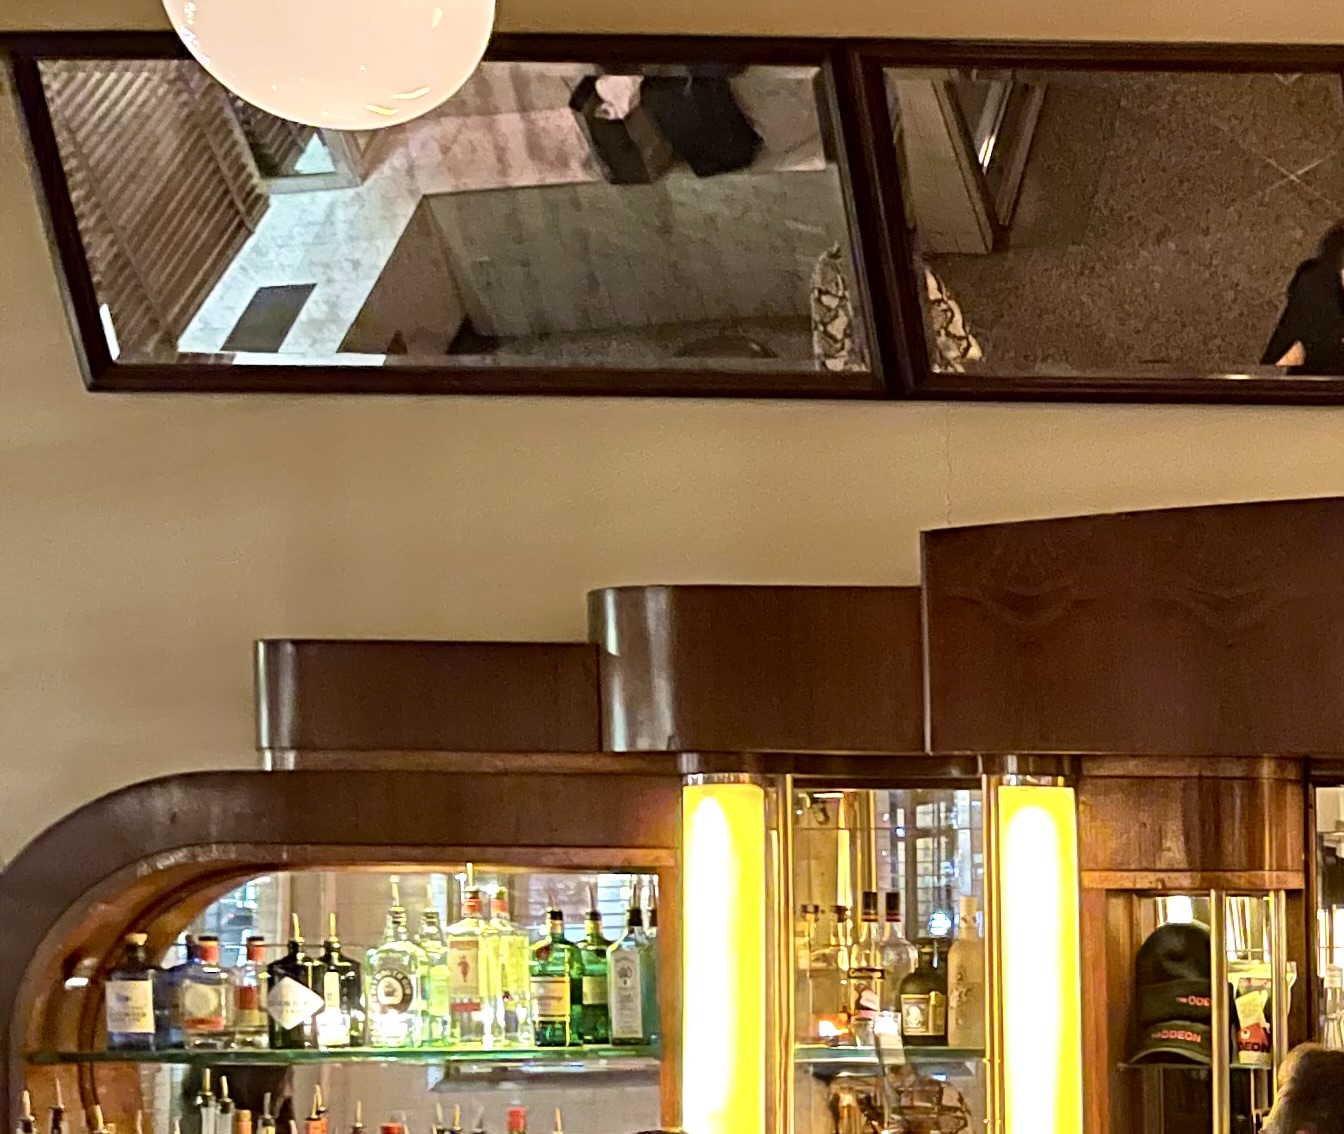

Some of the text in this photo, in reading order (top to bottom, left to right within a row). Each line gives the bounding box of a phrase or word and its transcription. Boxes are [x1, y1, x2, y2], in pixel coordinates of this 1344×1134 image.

[1188, 995, 1210, 1007] ODE
[1160, 1029, 1202, 1043] ODEON
[1238, 1041, 1270, 1053] DEON
